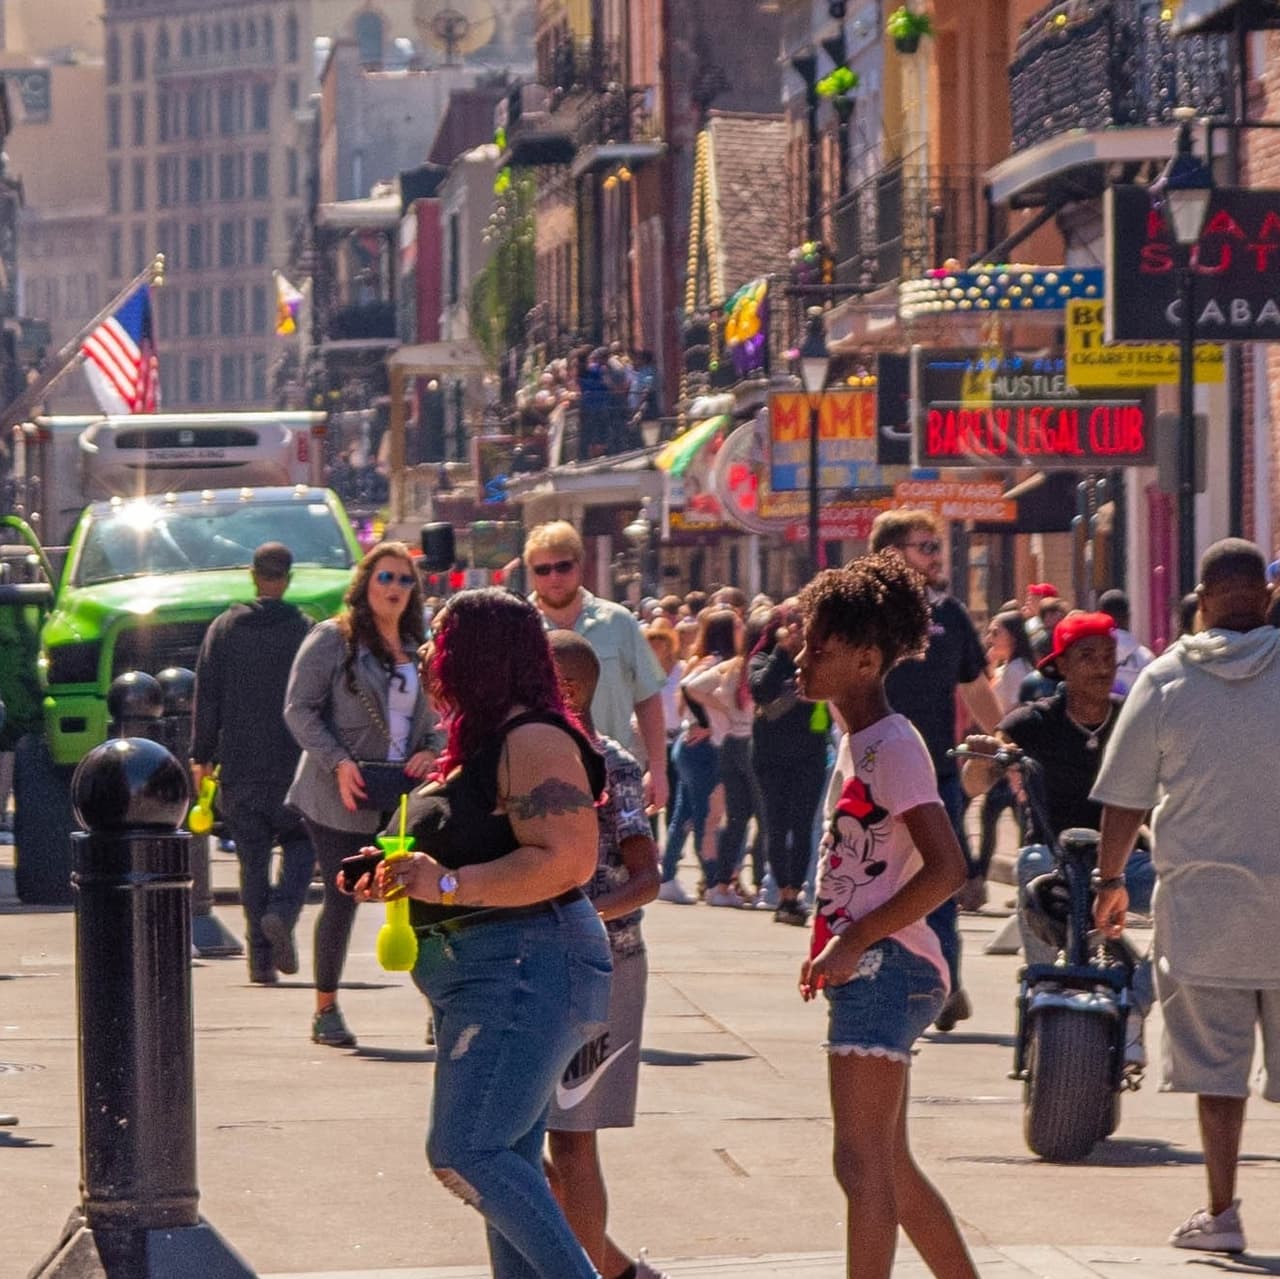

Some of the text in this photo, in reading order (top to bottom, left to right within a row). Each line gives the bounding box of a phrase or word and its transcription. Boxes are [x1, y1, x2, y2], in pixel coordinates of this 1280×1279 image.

[927, 407, 1010, 456] BARELY
[1016, 406, 1085, 456] LEGAL
[1089, 405, 1145, 454] CLUB
[942, 501, 1006, 518] MUSIC
[797, 525, 858, 538] DNING
[562, 1032, 609, 1082] NIKE
